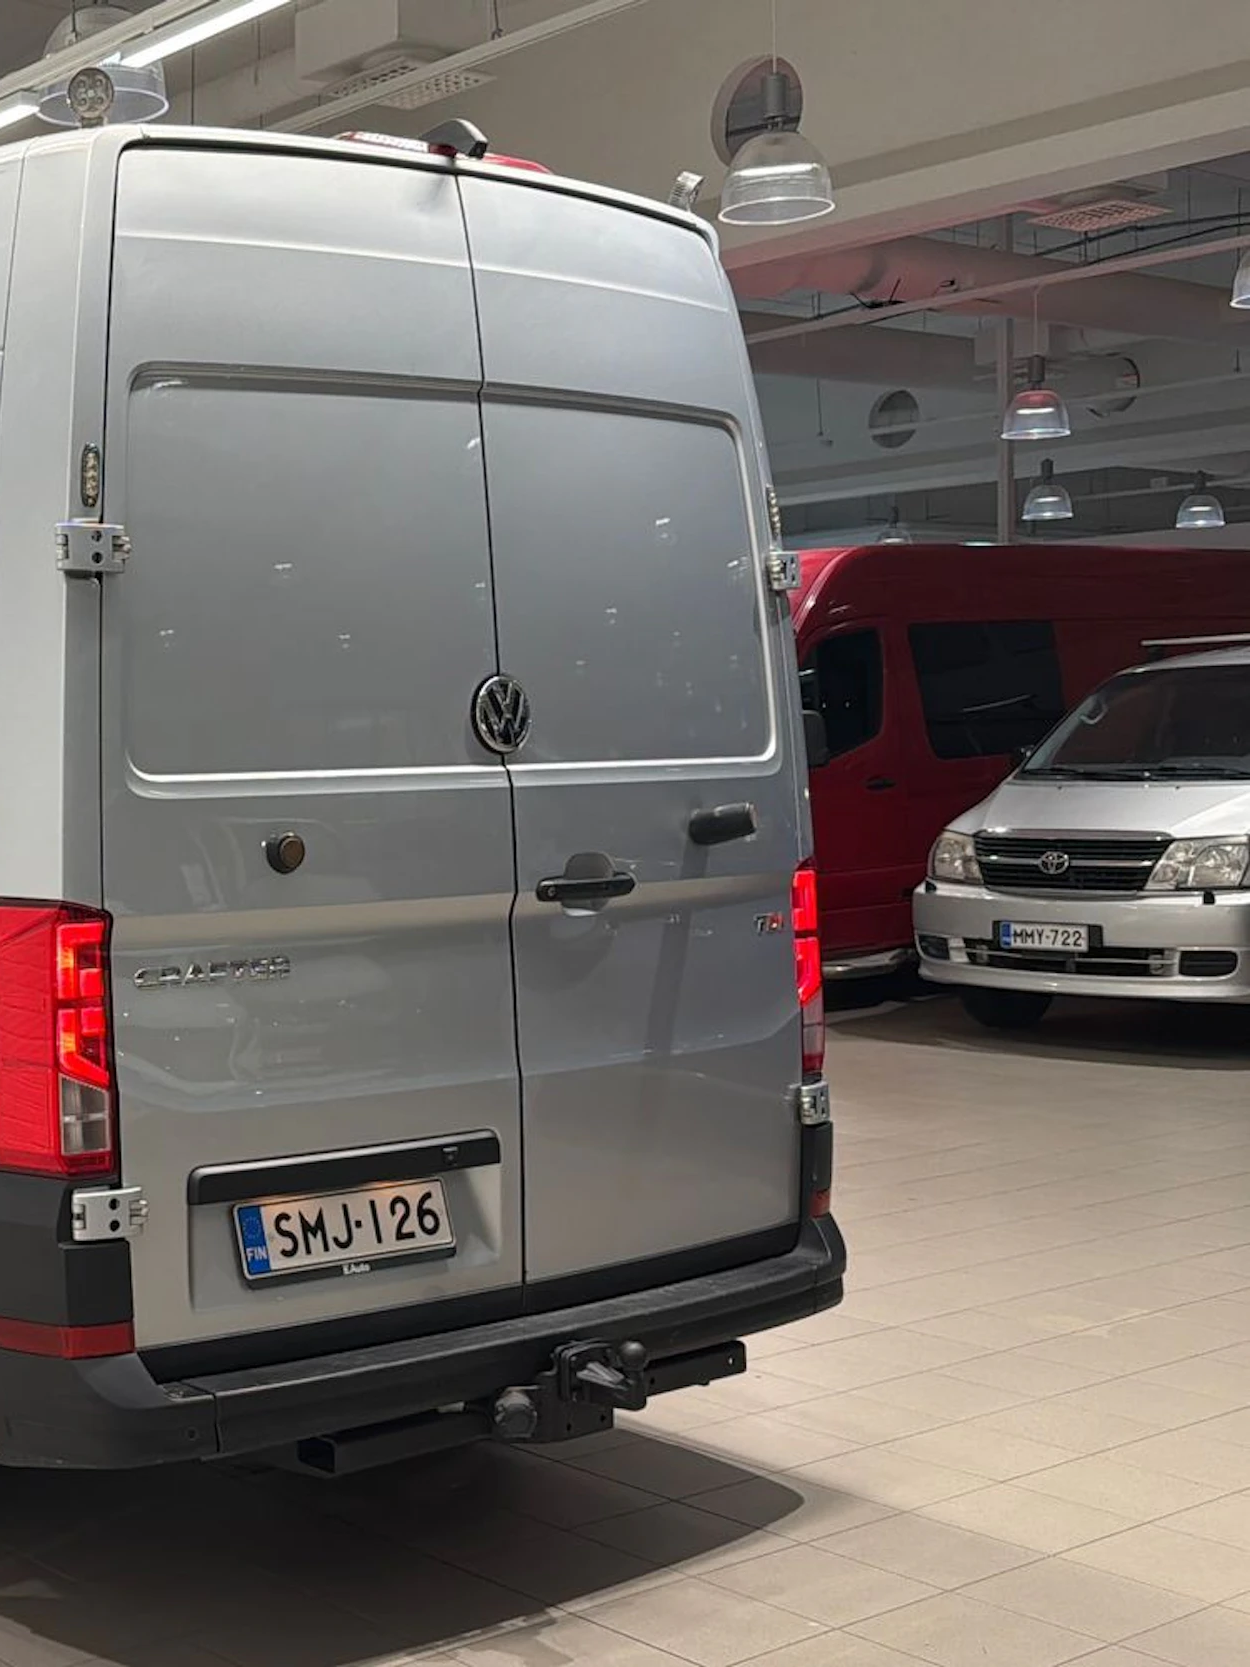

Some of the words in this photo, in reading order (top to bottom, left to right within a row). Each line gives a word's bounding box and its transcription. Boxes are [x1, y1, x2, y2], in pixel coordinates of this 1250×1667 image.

[1013, 928, 1083, 948] MMY-722
[134, 955, 291, 988] CRAFTER
[273, 1191, 441, 1259] SMJ-126
[246, 1245, 269, 1262] FIN
